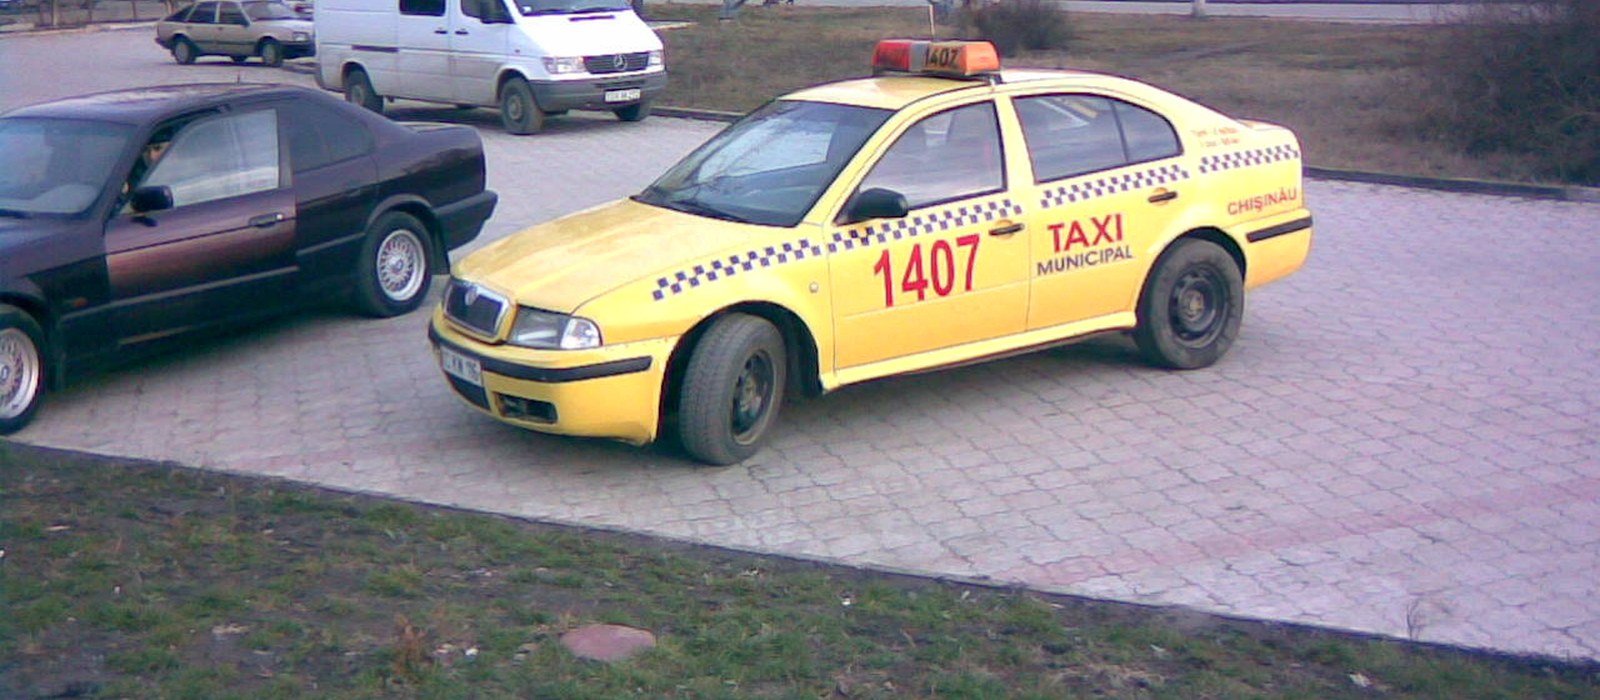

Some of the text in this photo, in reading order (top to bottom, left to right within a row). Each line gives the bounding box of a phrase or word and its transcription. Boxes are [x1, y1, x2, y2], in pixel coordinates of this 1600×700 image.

[924, 47, 960, 67] 1407
[1048, 213, 1123, 253] TAXI
[874, 233, 982, 308] 1407
[1036, 245, 1134, 276] MUNICIPAL
